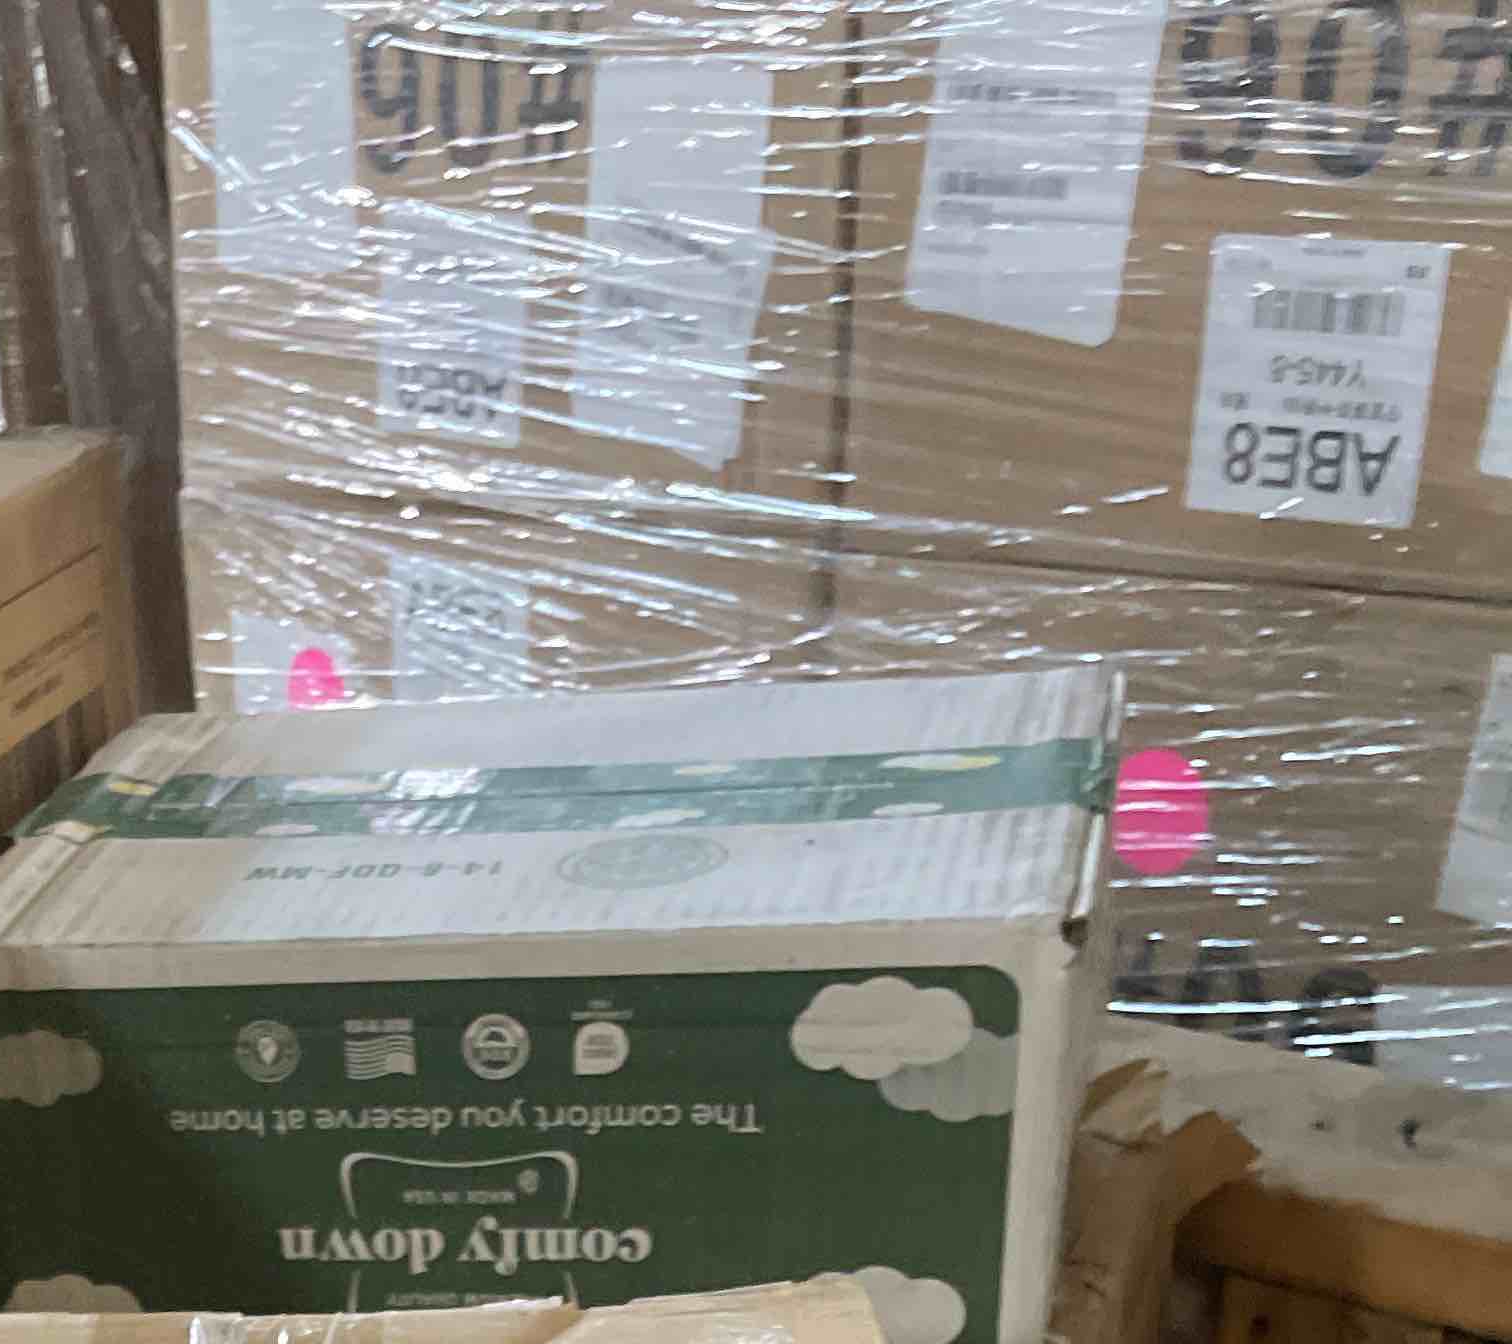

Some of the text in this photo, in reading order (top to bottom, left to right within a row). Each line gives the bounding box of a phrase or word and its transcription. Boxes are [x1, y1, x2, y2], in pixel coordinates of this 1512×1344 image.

[1224, 422, 1400, 497] ABE8
[168, 1099, 763, 1138] The comfort you deserve at home
[276, 1215, 653, 1277] comfy down
